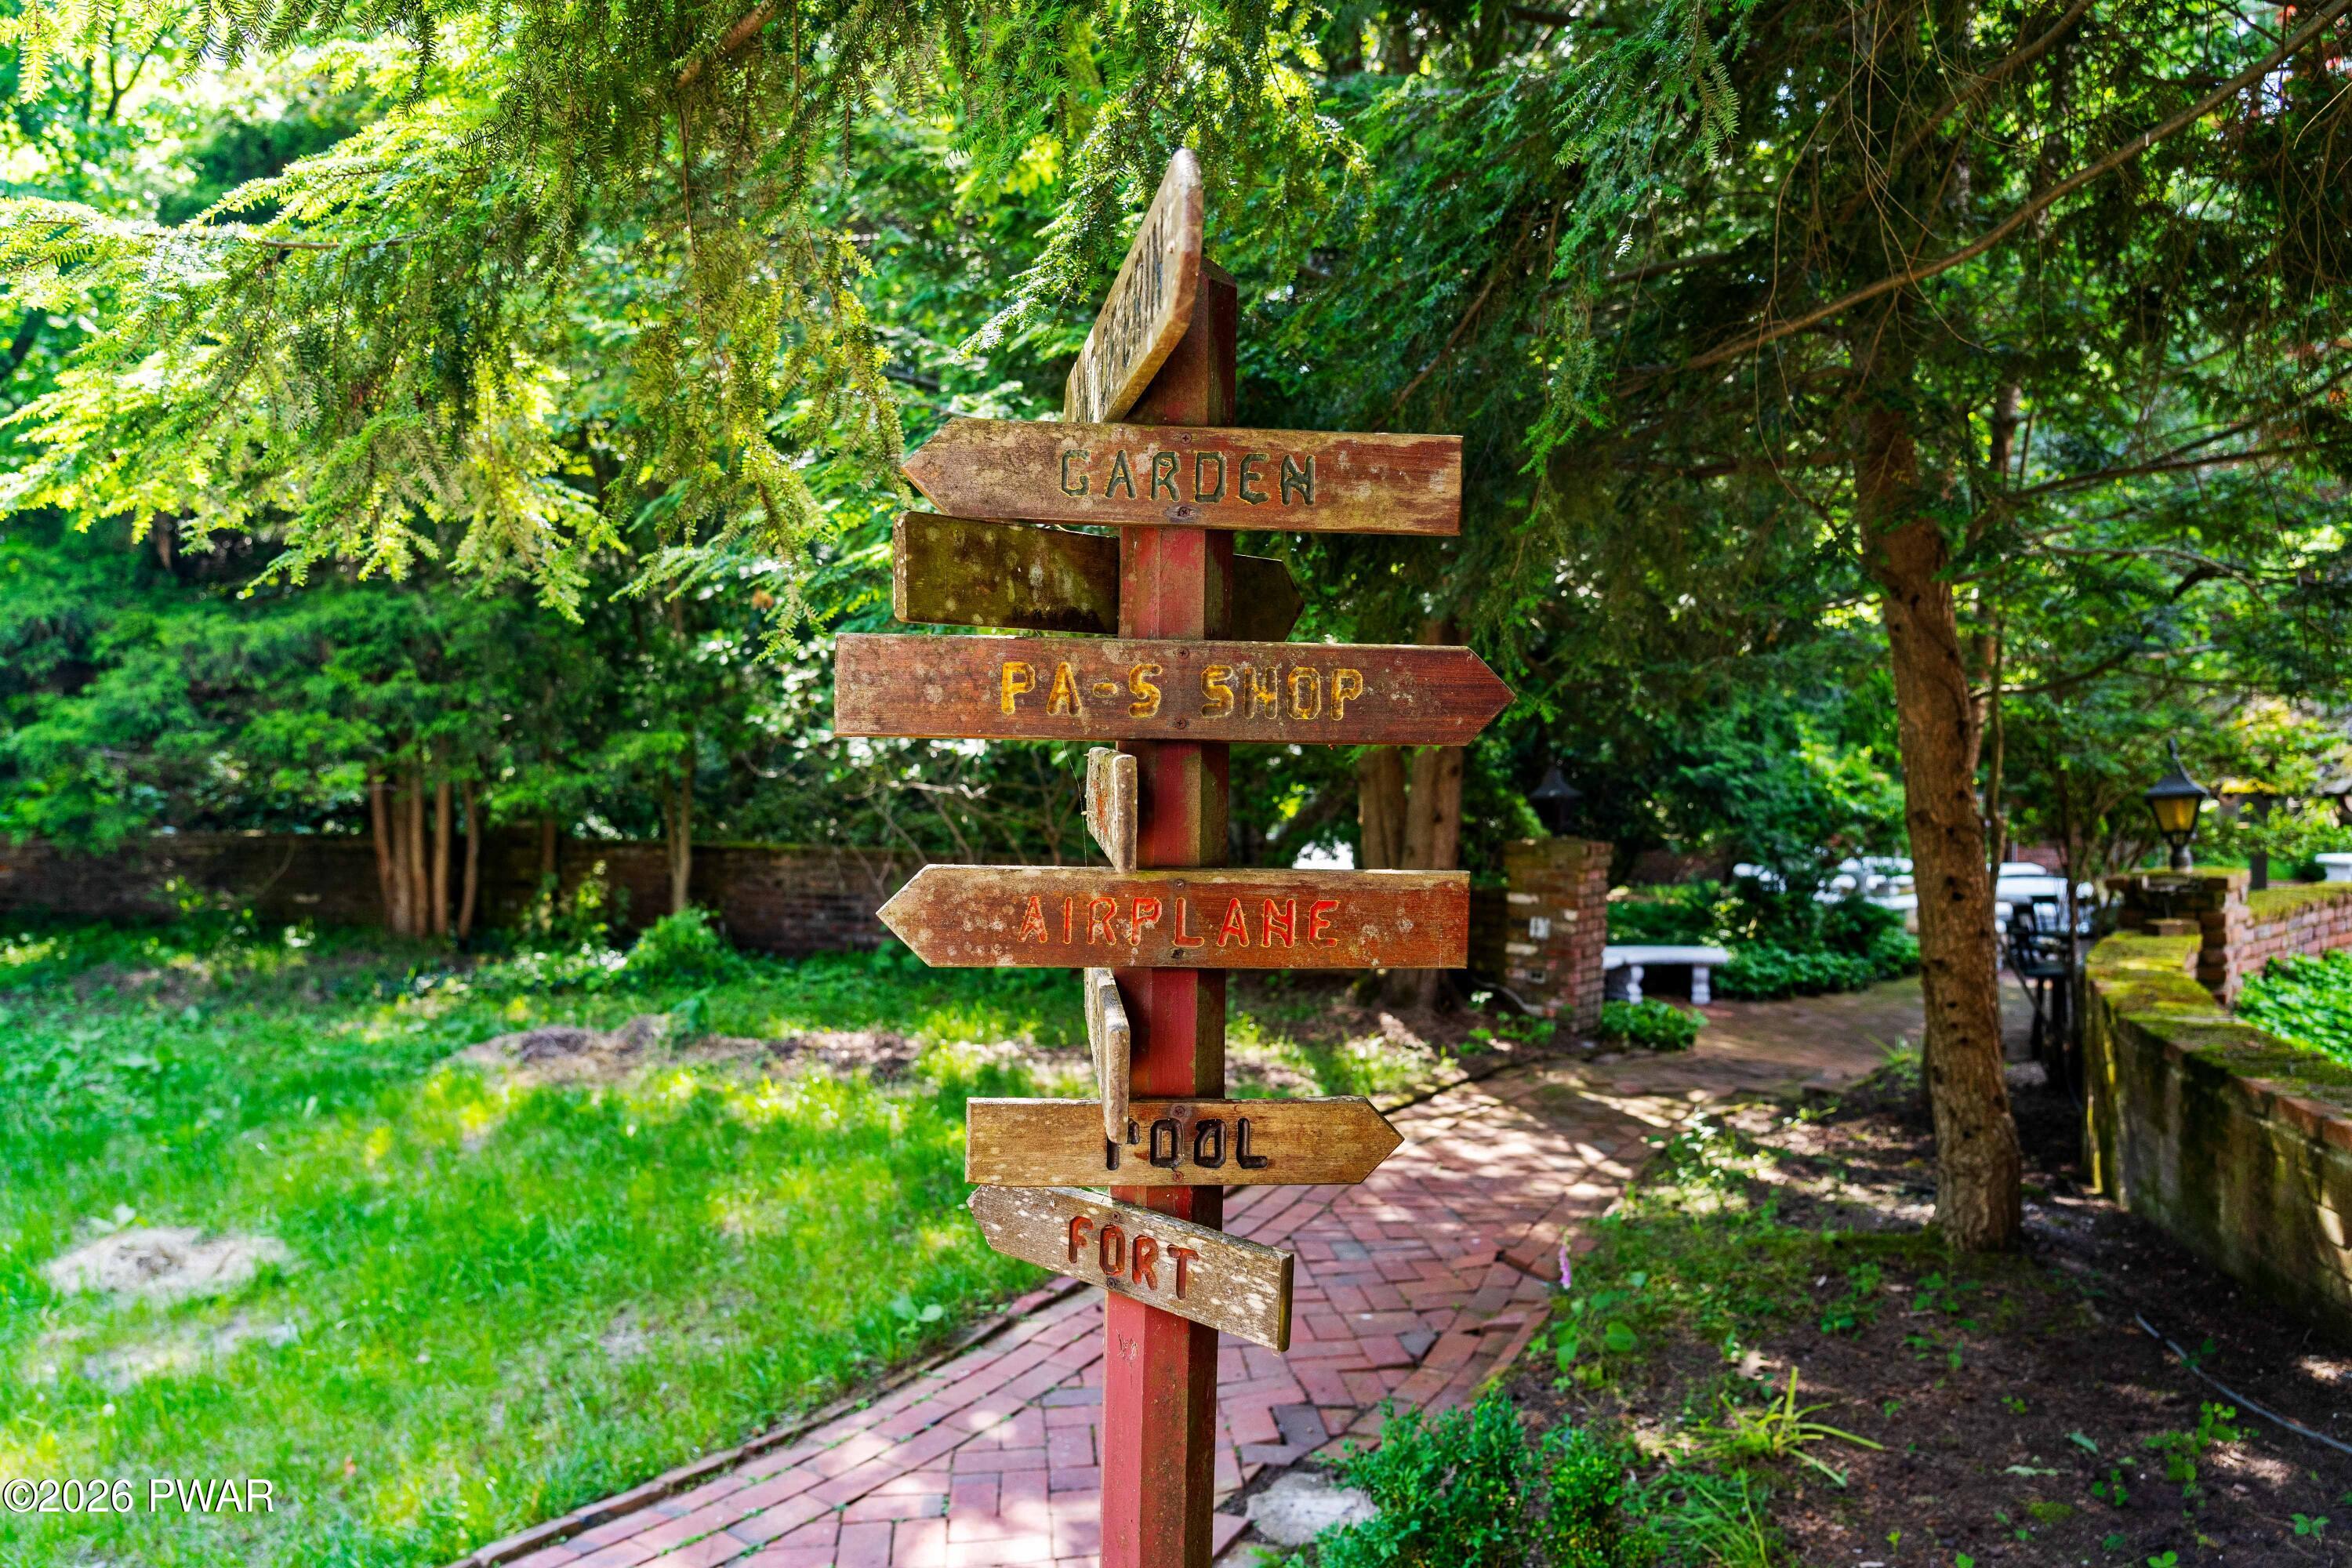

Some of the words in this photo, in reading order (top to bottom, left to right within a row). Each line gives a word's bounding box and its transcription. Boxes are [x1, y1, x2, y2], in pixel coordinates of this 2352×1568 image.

[1060, 448, 1316, 506] GARDEN
[1000, 661, 1164, 719] PA-S
[1200, 664, 1364, 721] SHOP
[1018, 895, 1340, 949] AIRPLANE
[1068, 1215, 1200, 1300] FORT
